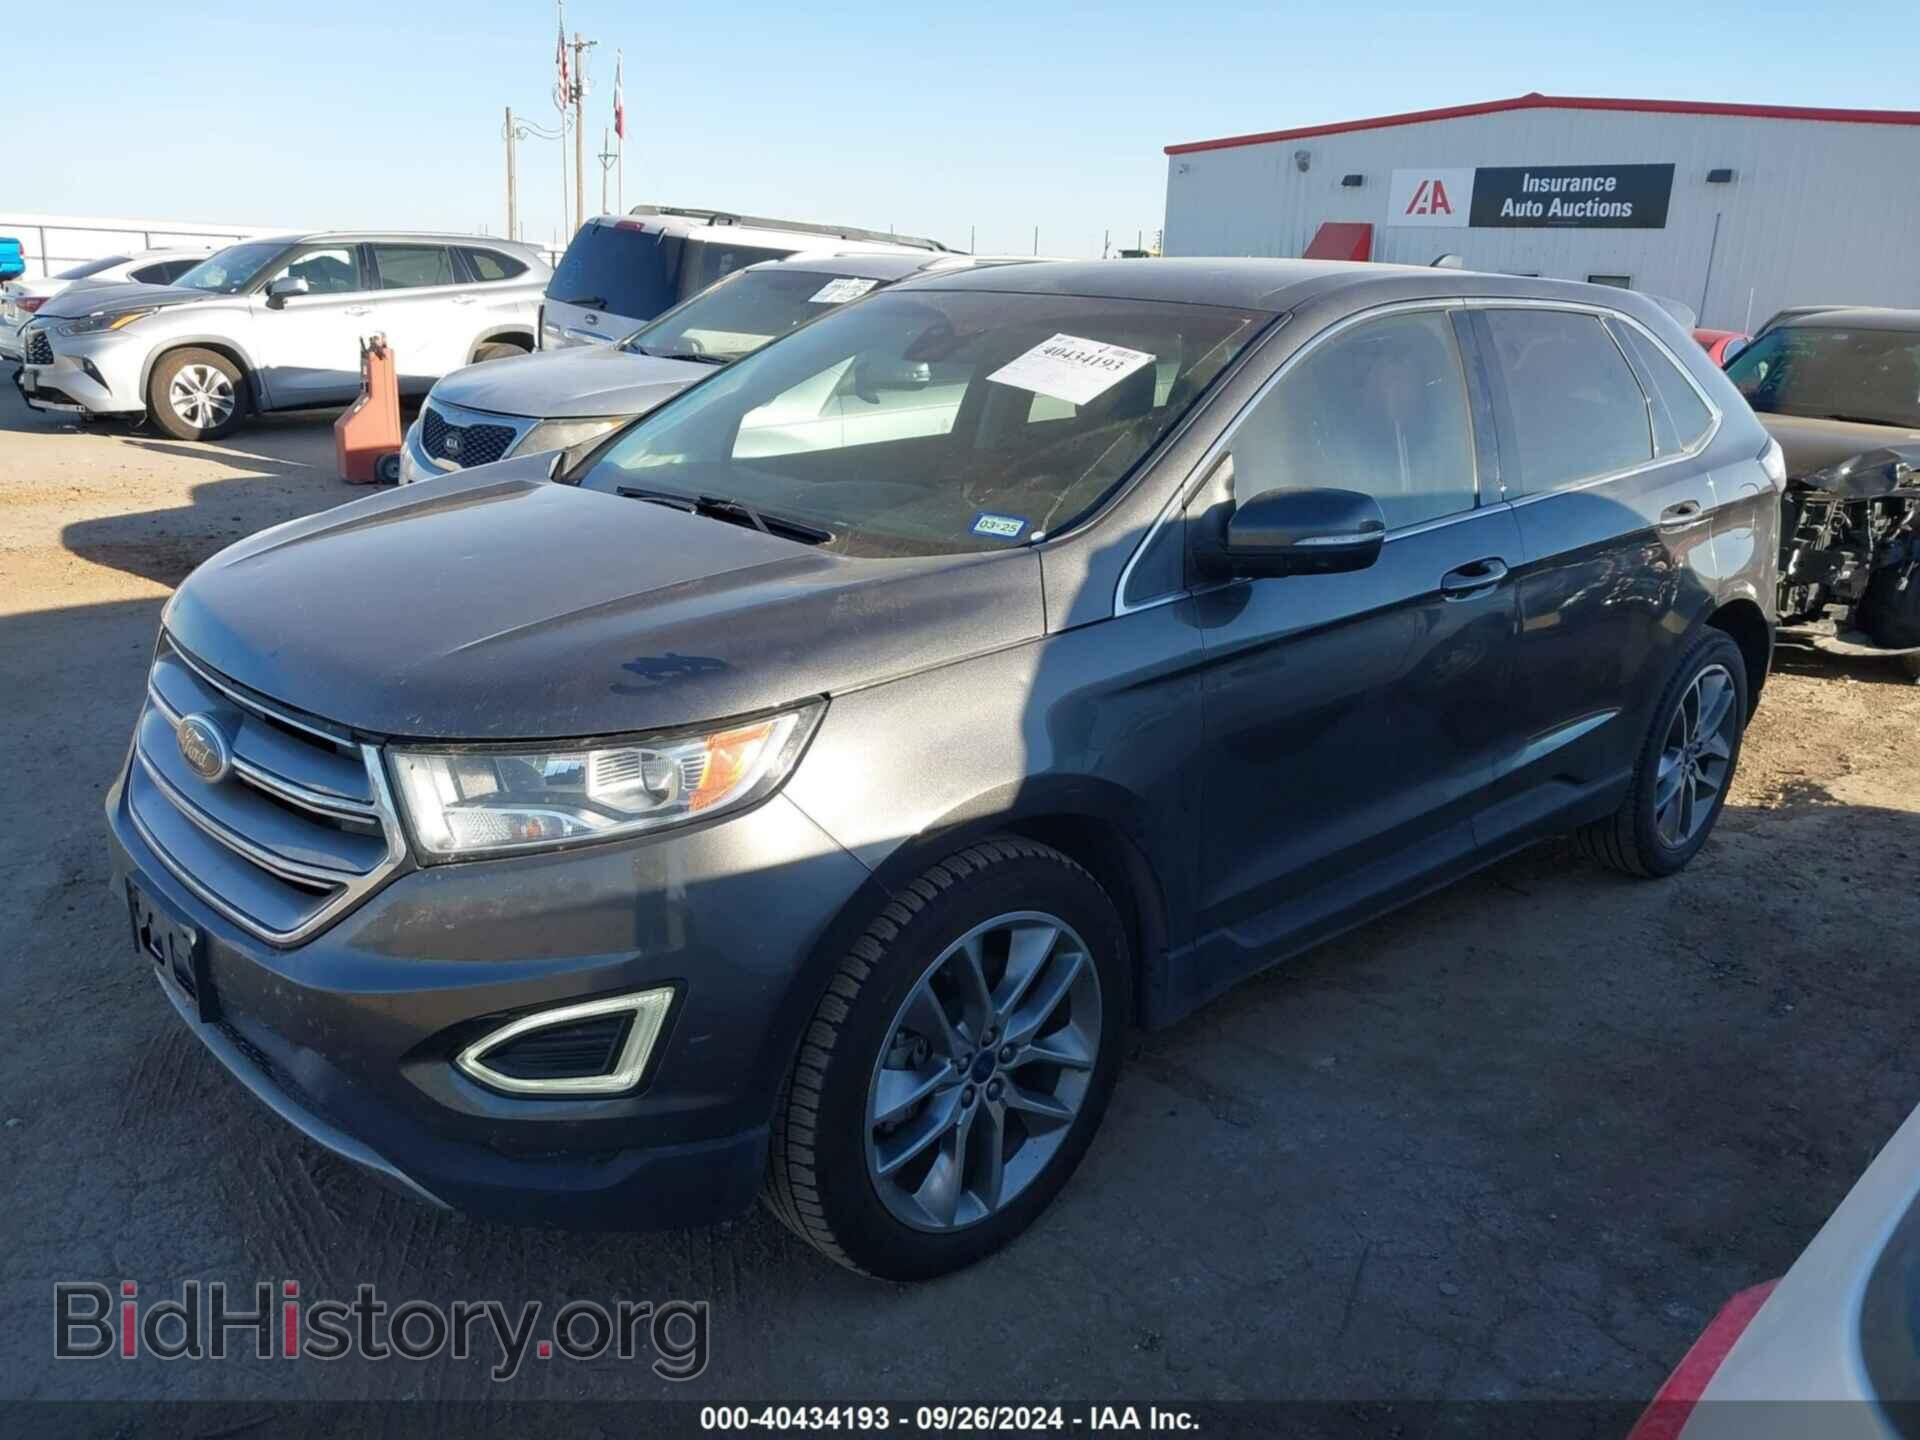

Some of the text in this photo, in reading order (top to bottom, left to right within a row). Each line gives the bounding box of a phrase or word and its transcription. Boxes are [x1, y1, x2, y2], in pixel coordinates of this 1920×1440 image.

[1523, 173, 1617, 193] Insurance
[1500, 197, 1633, 217] Auto Auctions
[1044, 346, 1125, 371] 40434193
[183, 727, 211, 770] Ford
